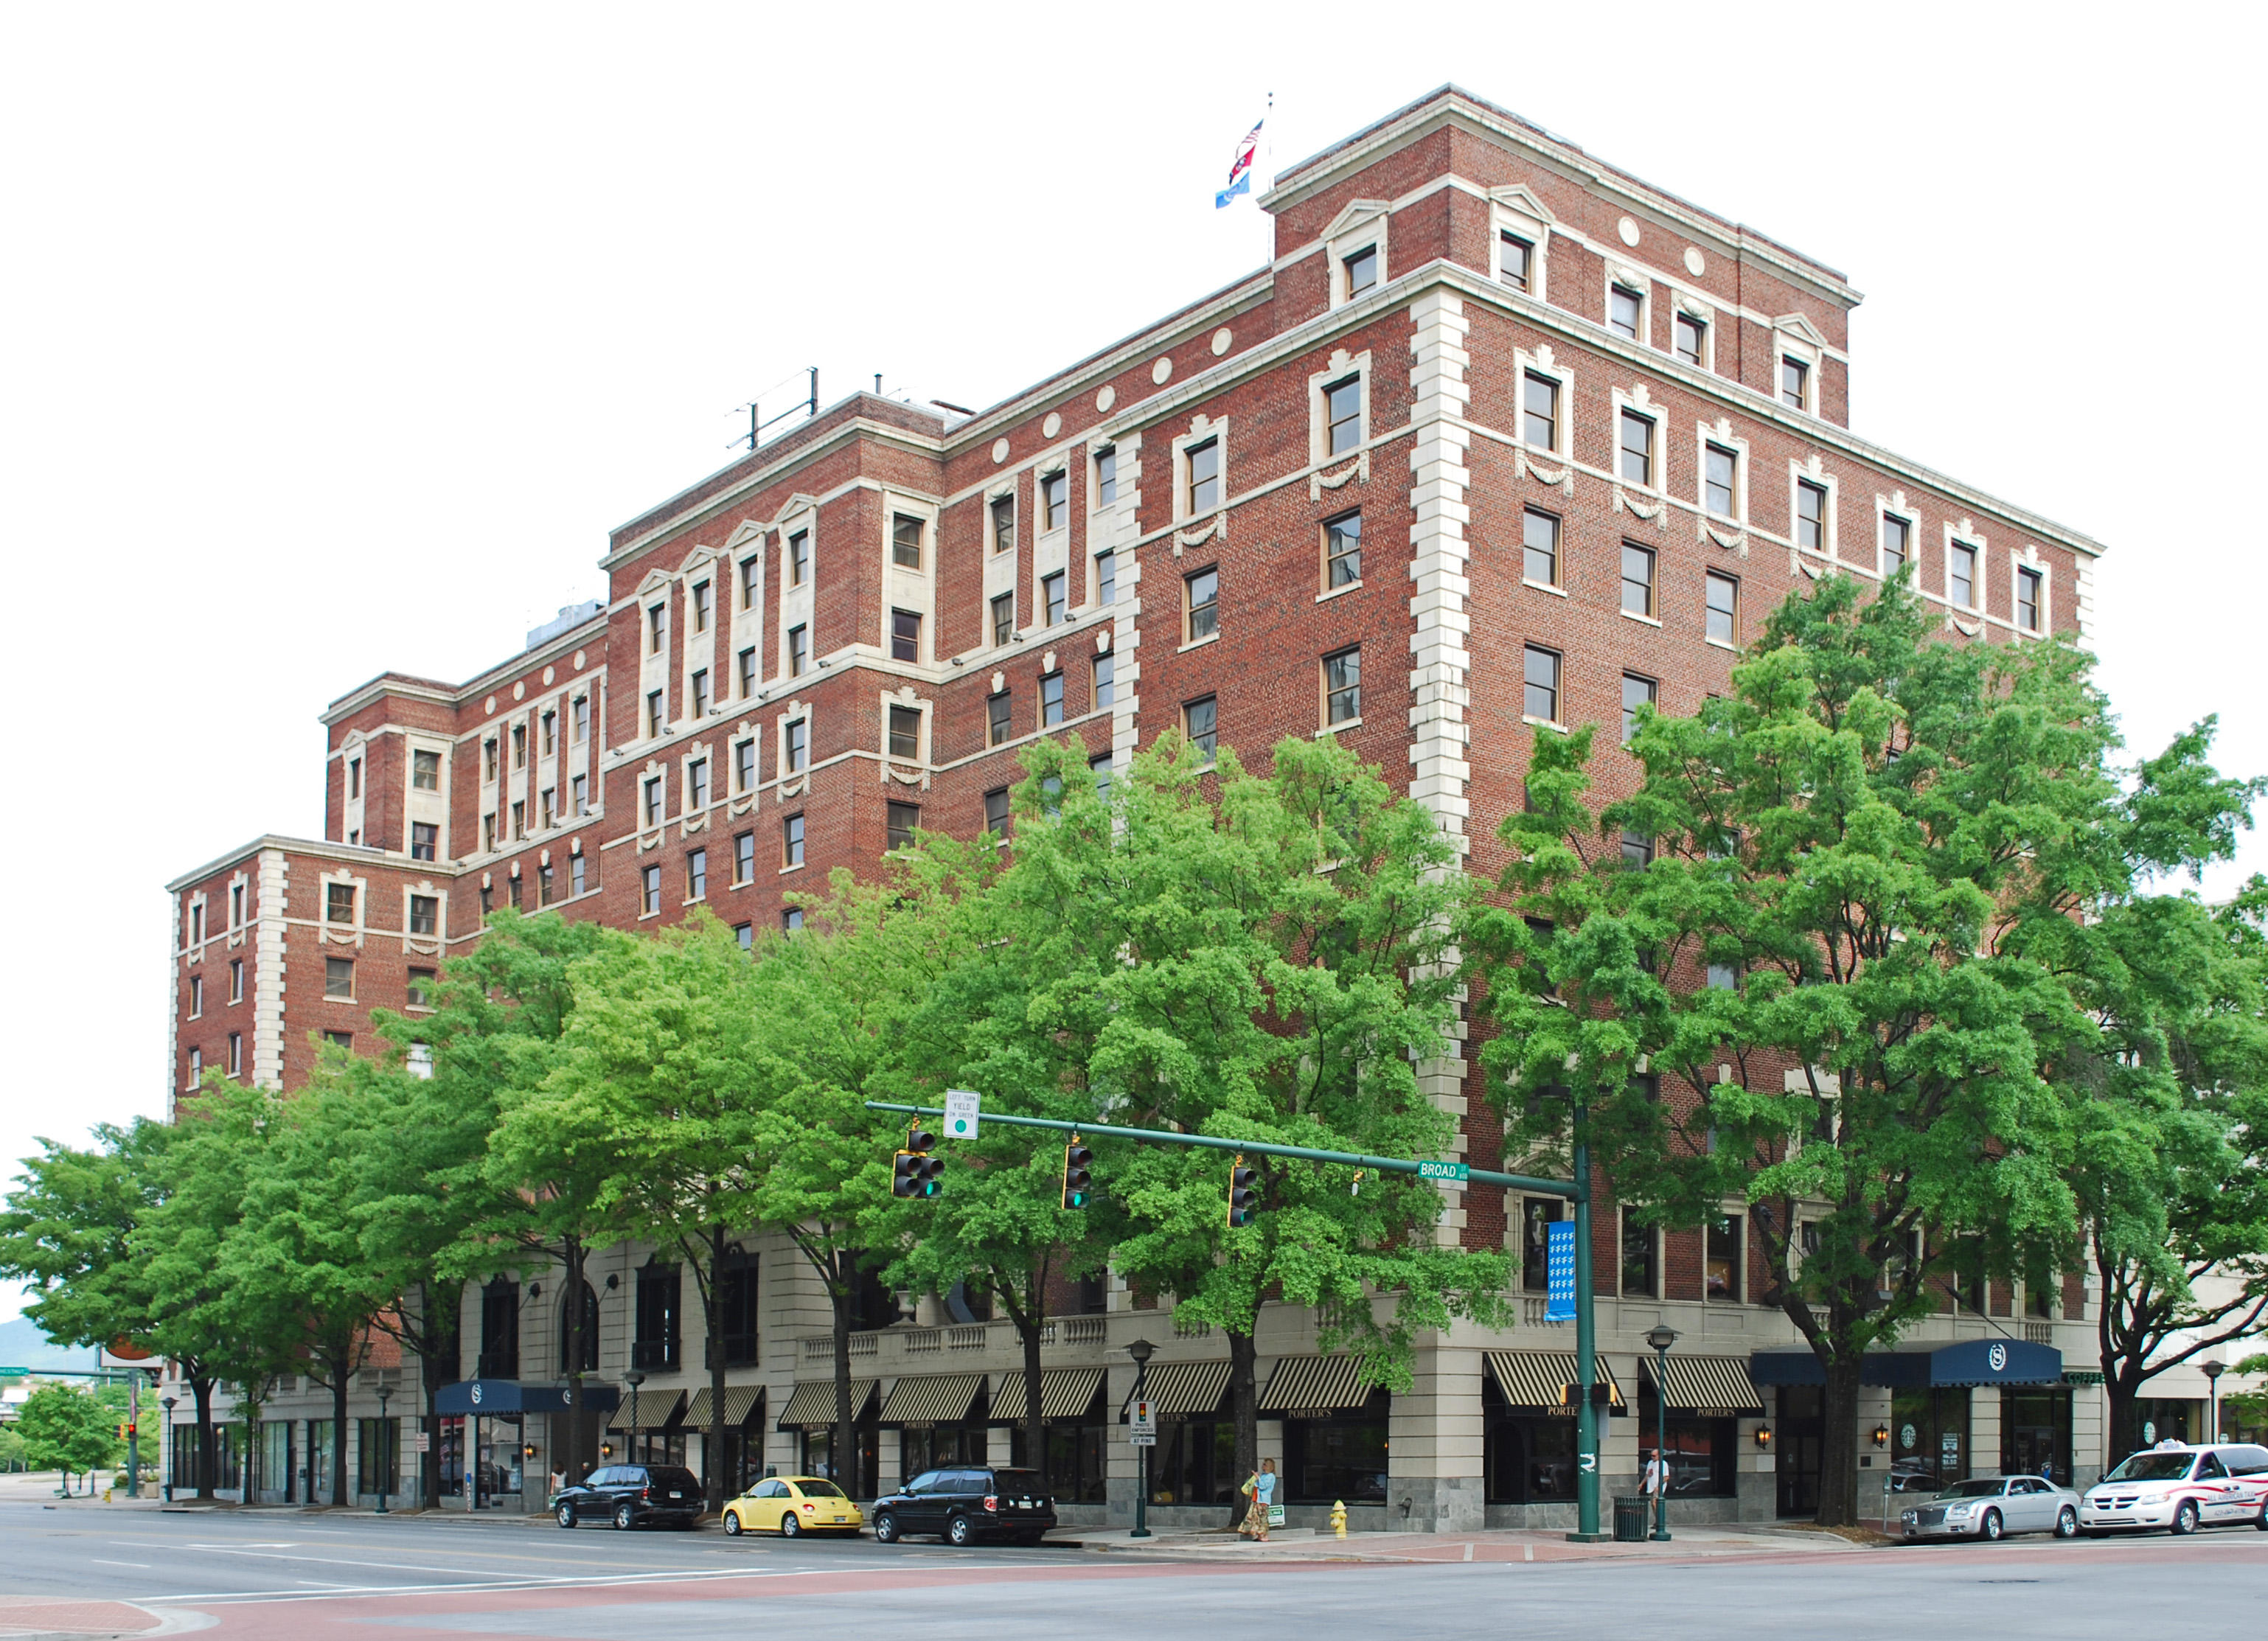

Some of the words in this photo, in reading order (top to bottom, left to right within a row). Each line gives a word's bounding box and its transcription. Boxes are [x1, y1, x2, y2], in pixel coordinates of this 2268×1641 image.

[1421, 1163, 1456, 1178] BROAD
[2067, 1373, 2105, 1384] COFFEE
[1287, 1409, 1332, 1419] PORTER'S
[1548, 1406, 1577, 1415] PORTE
[1697, 1407, 1735, 1417] PORTER'S
[1018, 1418, 1052, 1426] POR'S
[1156, 1412, 1189, 1422] ORTER'S
[904, 1421, 935, 1429] PORTER'S
[2218, 1491, 2243, 1500] AMERICAN
